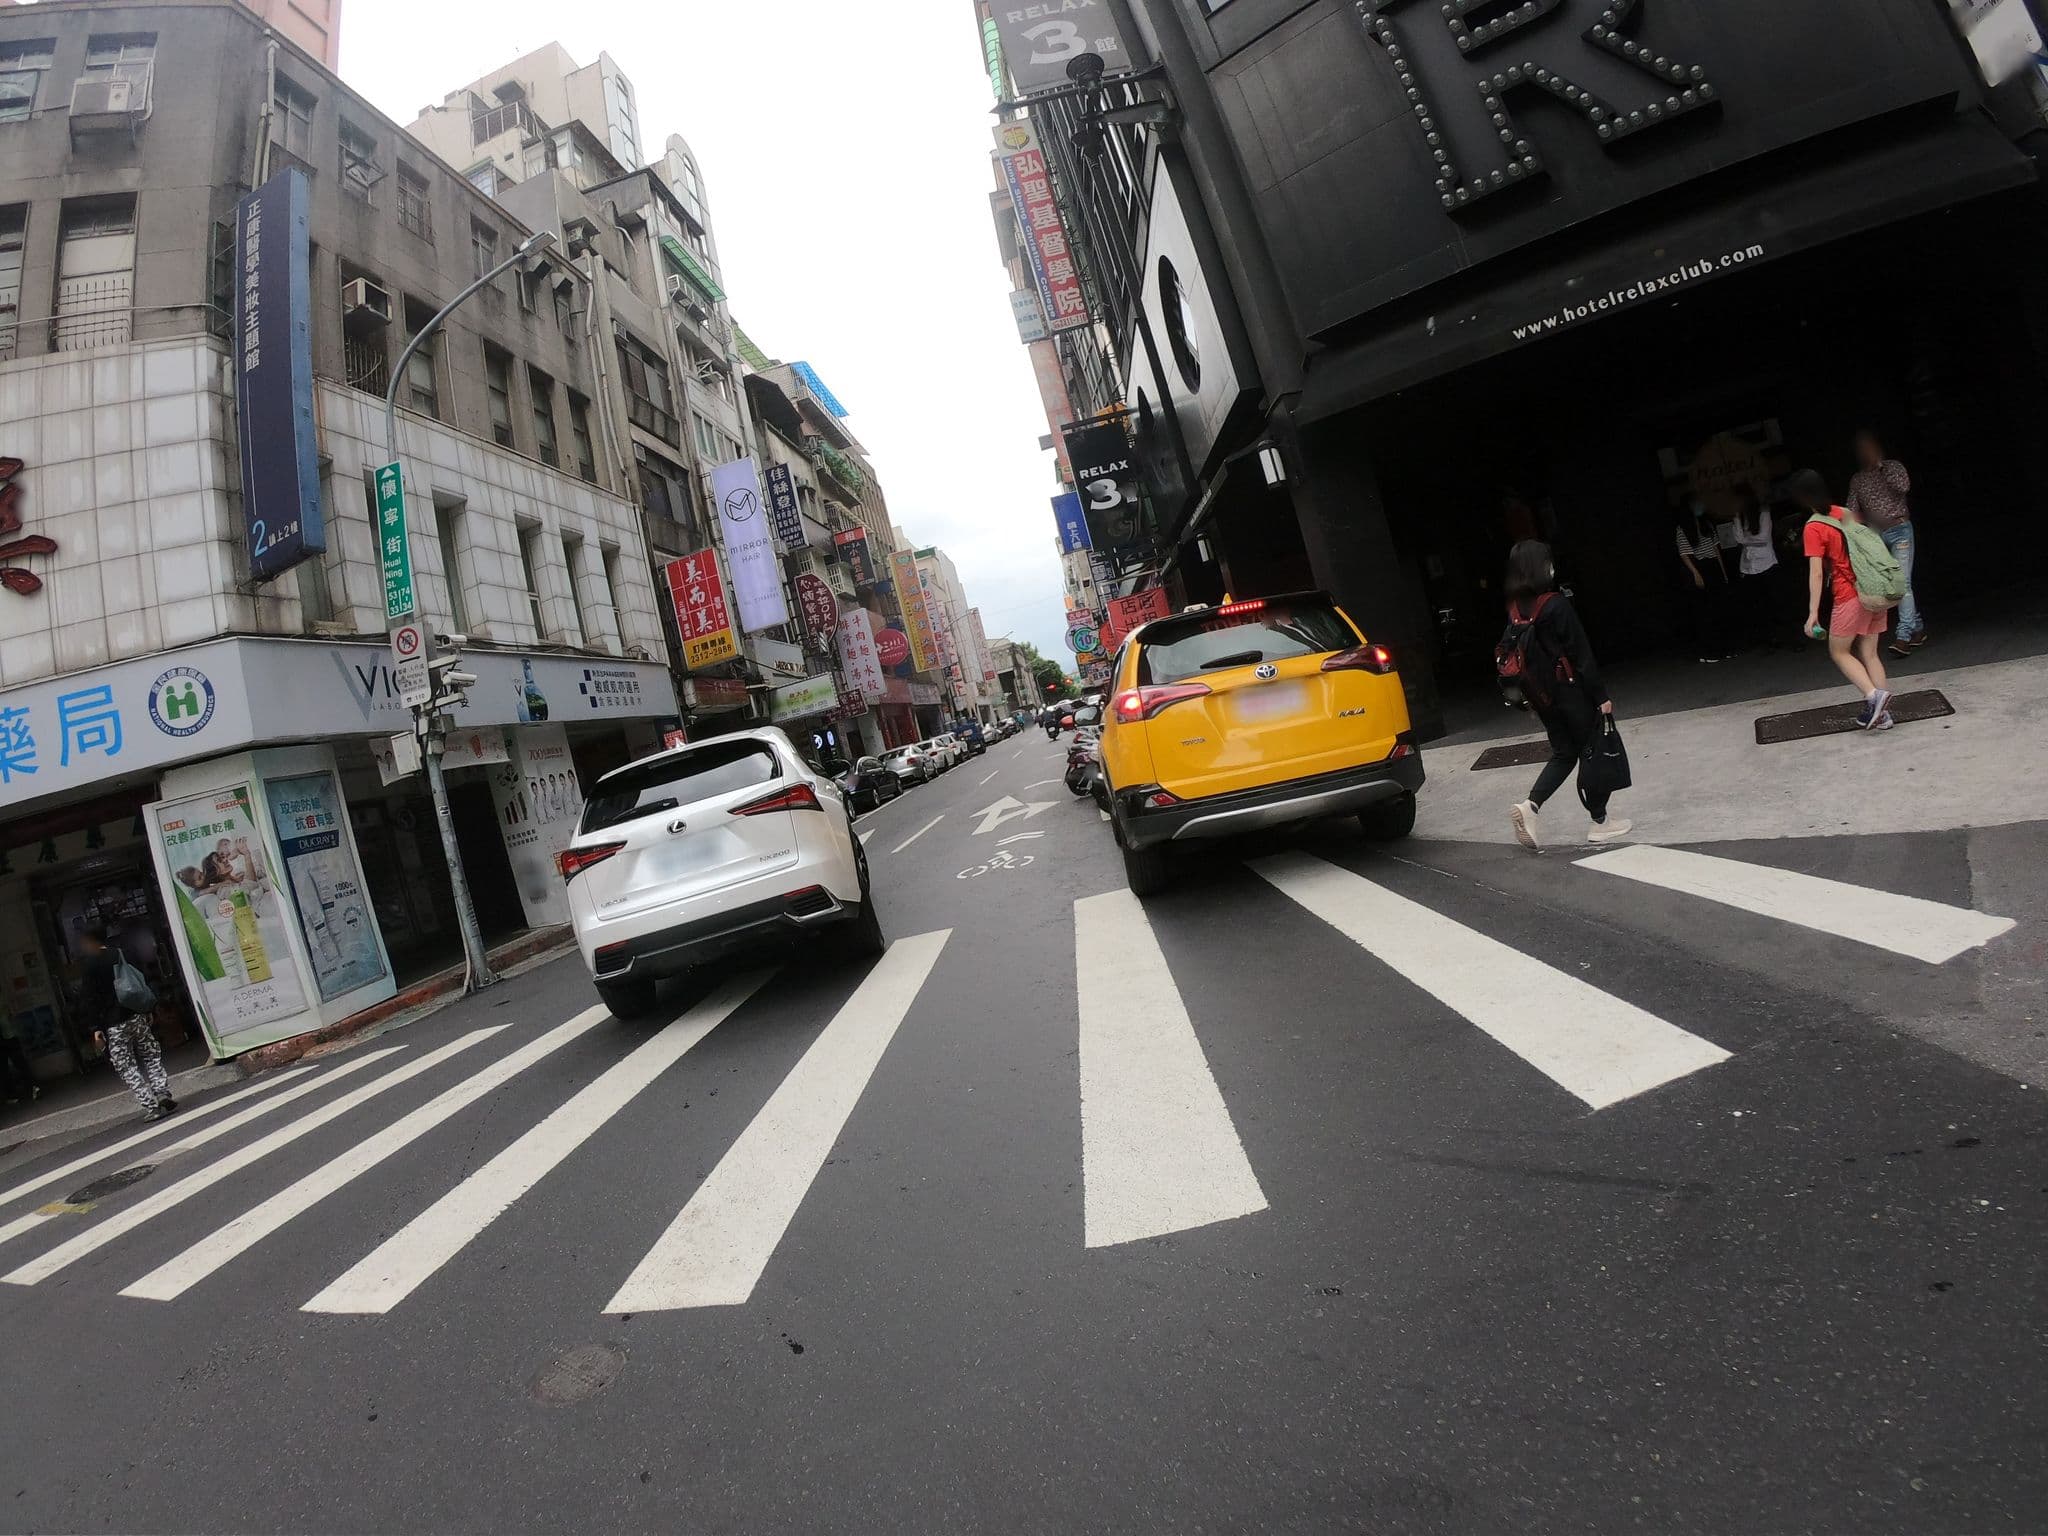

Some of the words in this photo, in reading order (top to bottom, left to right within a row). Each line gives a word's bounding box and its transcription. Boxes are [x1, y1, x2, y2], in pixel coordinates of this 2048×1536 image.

[1021, 20, 1087, 65] 3
[1015, 153, 1086, 314] 弘聖基督學院
[1512, 243, 1764, 340] www.hotelrelaxclub.com
[1079, 459, 1129, 480] RELAX
[1084, 478, 1122, 510] 3
[252, 519, 268, 558] 2
[381, 479, 402, 556] 懷寧街
[385, 568, 403, 580] Ning
[685, 559, 713, 633] 美而美
[299, 834, 330, 849] DUCRAY
